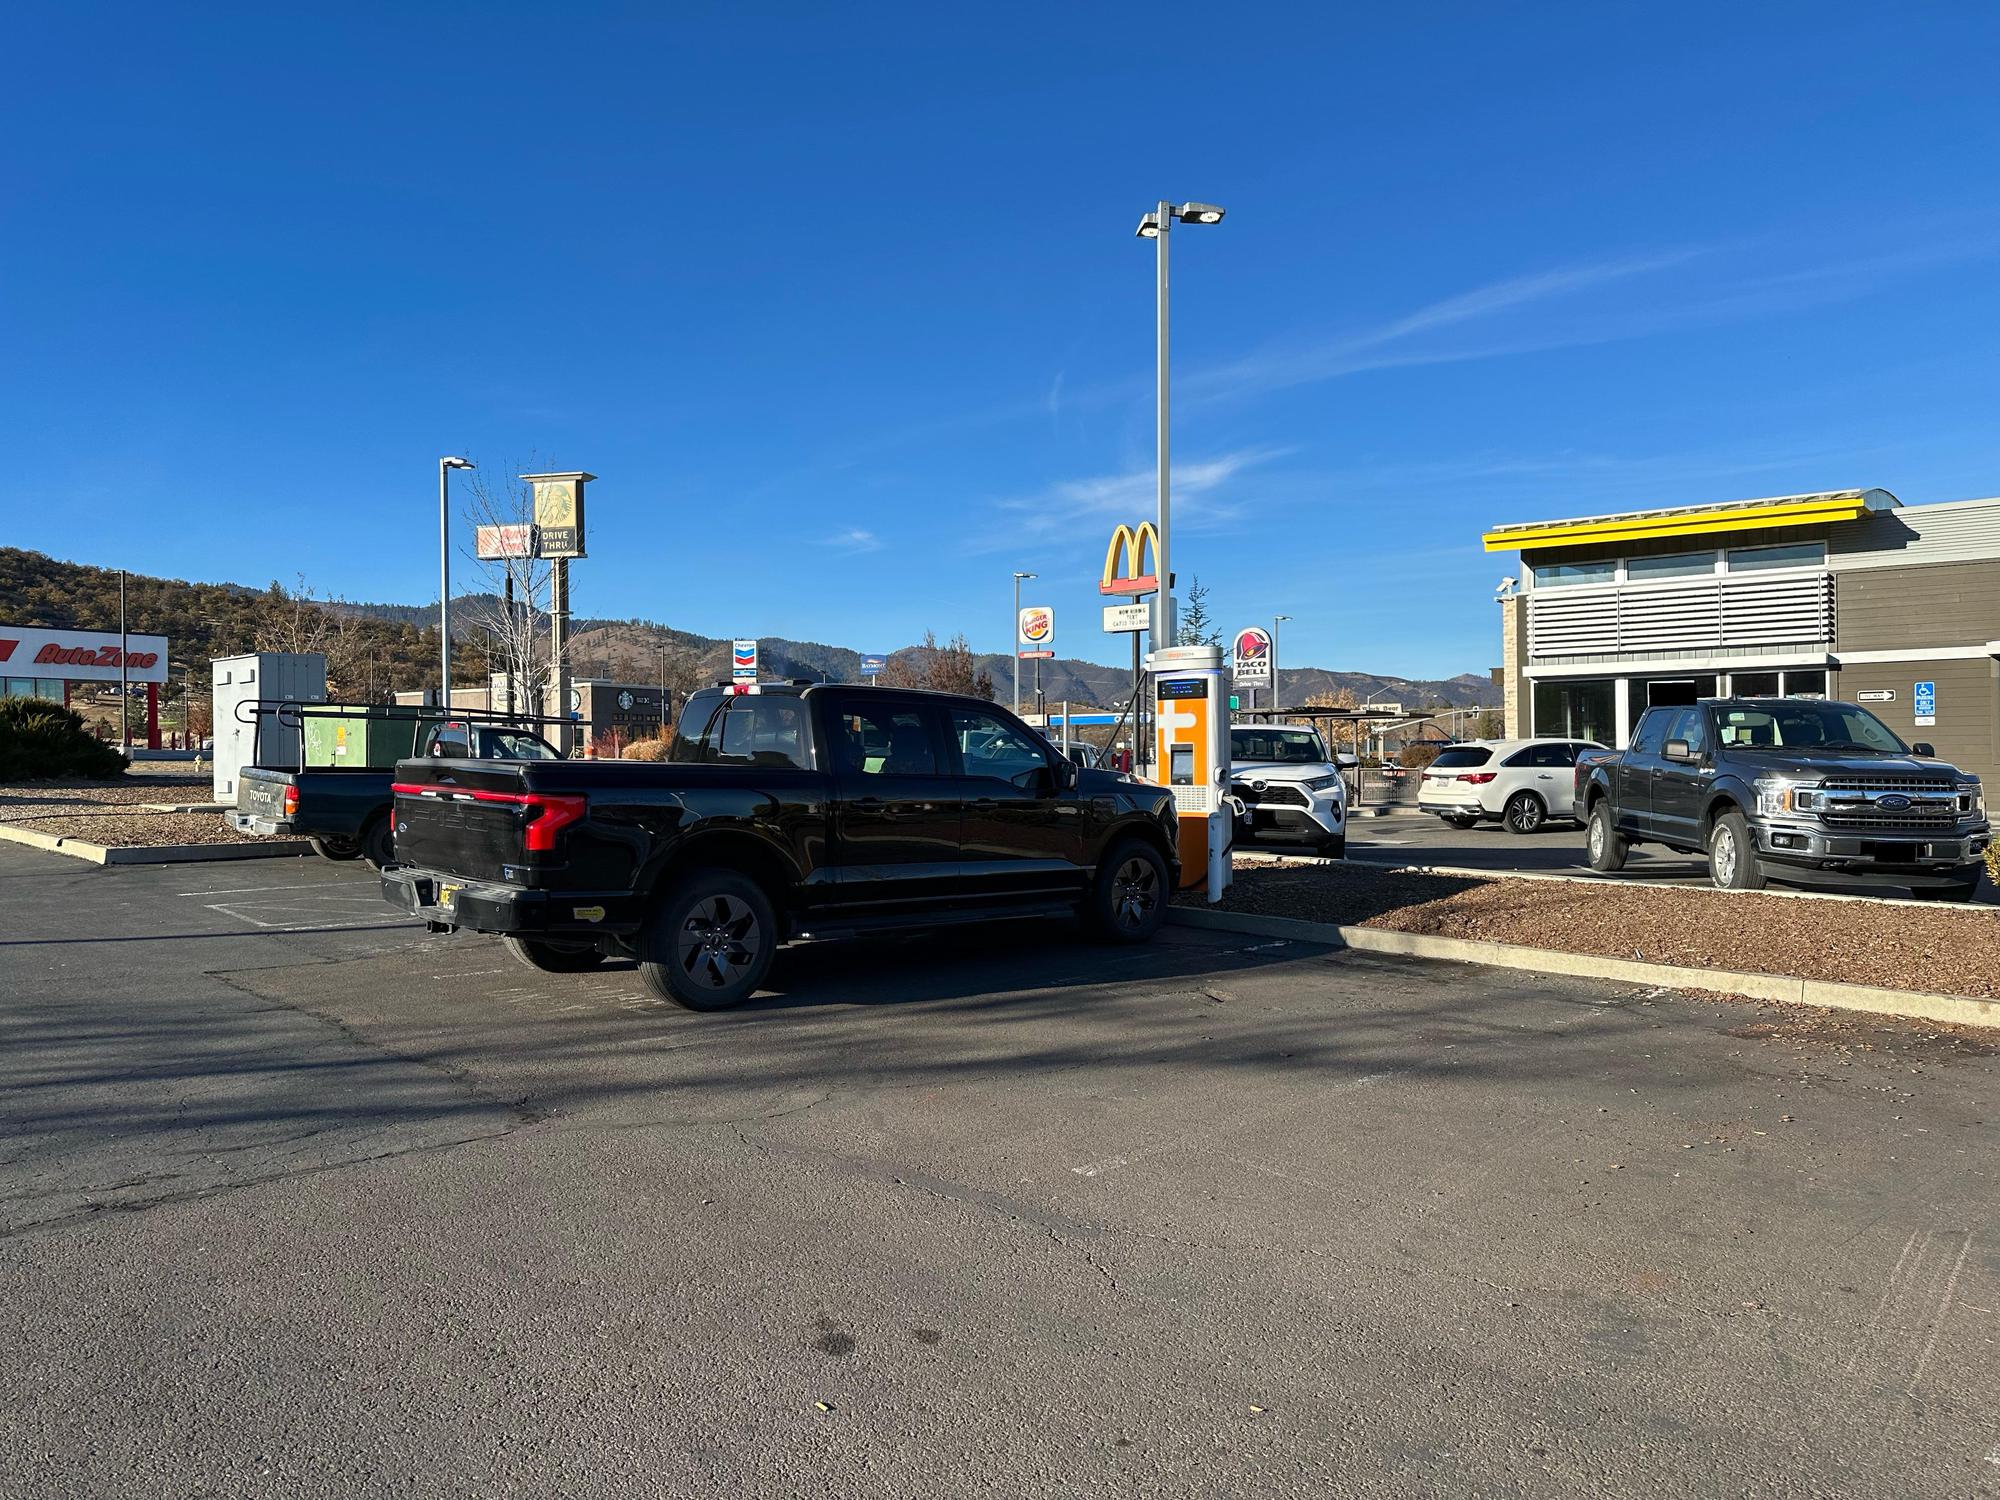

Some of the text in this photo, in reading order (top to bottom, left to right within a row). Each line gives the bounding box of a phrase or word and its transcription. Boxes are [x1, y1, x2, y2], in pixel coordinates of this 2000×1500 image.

[542, 531, 568, 539] DRIVE
[544, 541, 567, 550] THRU
[1025, 621, 1048, 635] KING
[34, 643, 158, 668] AutoZone
[250, 790, 271, 803] TOYOTA
